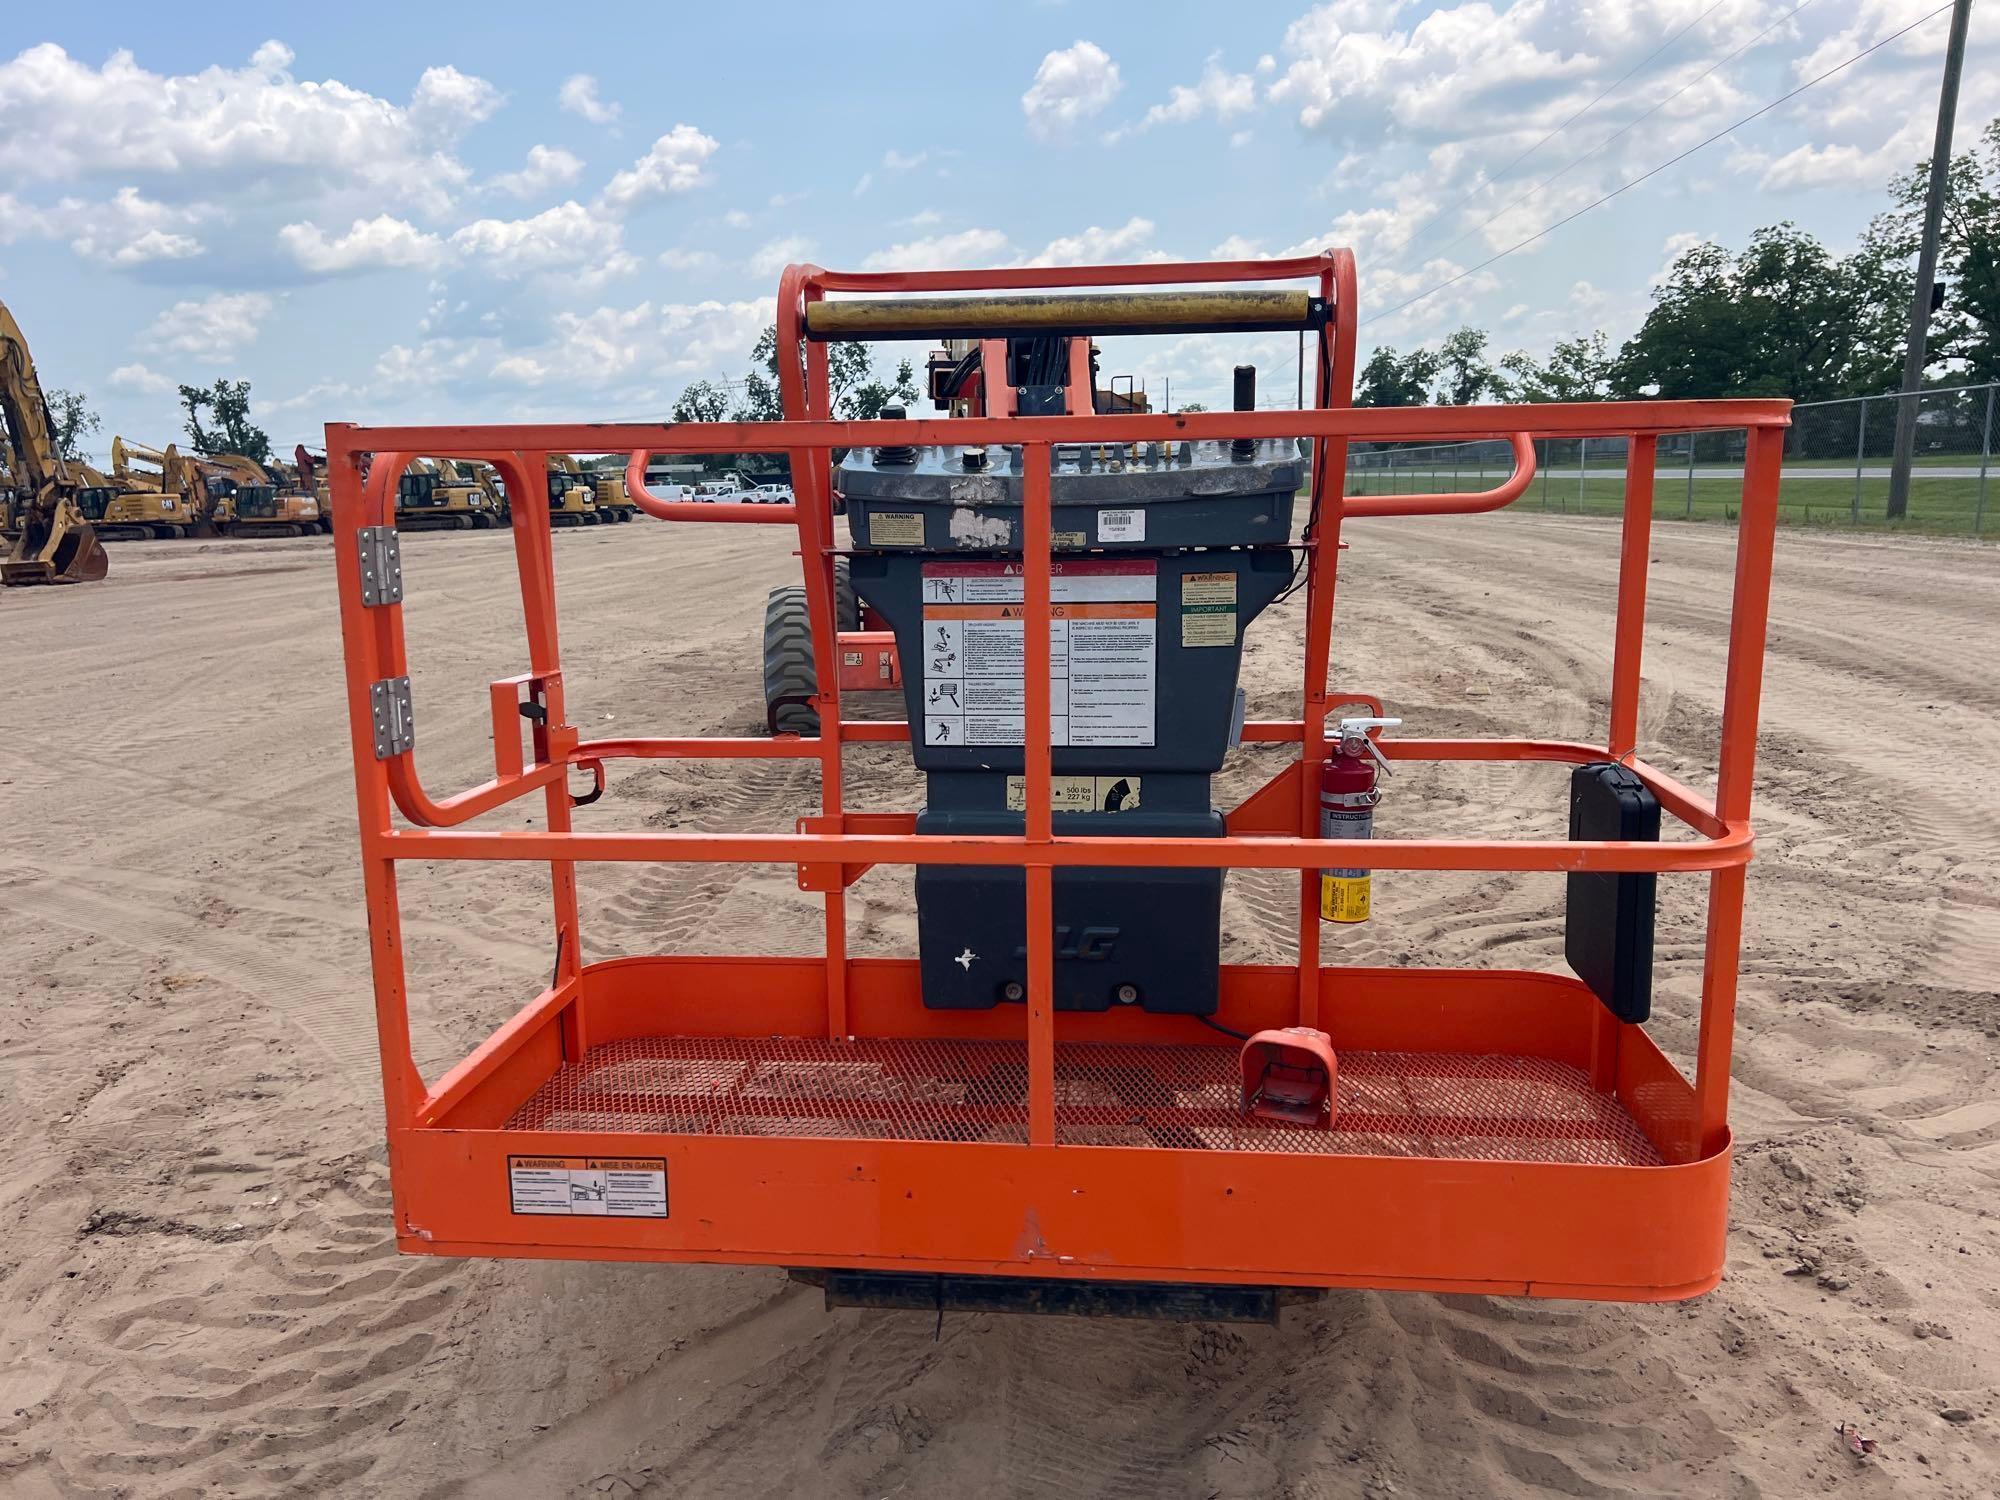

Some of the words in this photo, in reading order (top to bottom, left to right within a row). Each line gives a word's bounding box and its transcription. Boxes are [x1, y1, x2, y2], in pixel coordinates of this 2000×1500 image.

[1015, 563, 1063, 574] DER
[1066, 786, 1079, 794] 500
[1080, 786, 1092, 794] lbs
[1081, 793, 1091, 801] kg
[523, 1160, 566, 1169] WARNING
[600, 1161, 620, 1169] MISE
[621, 1161, 634, 1169] EN
[634, 1161, 663, 1170] GARDE
